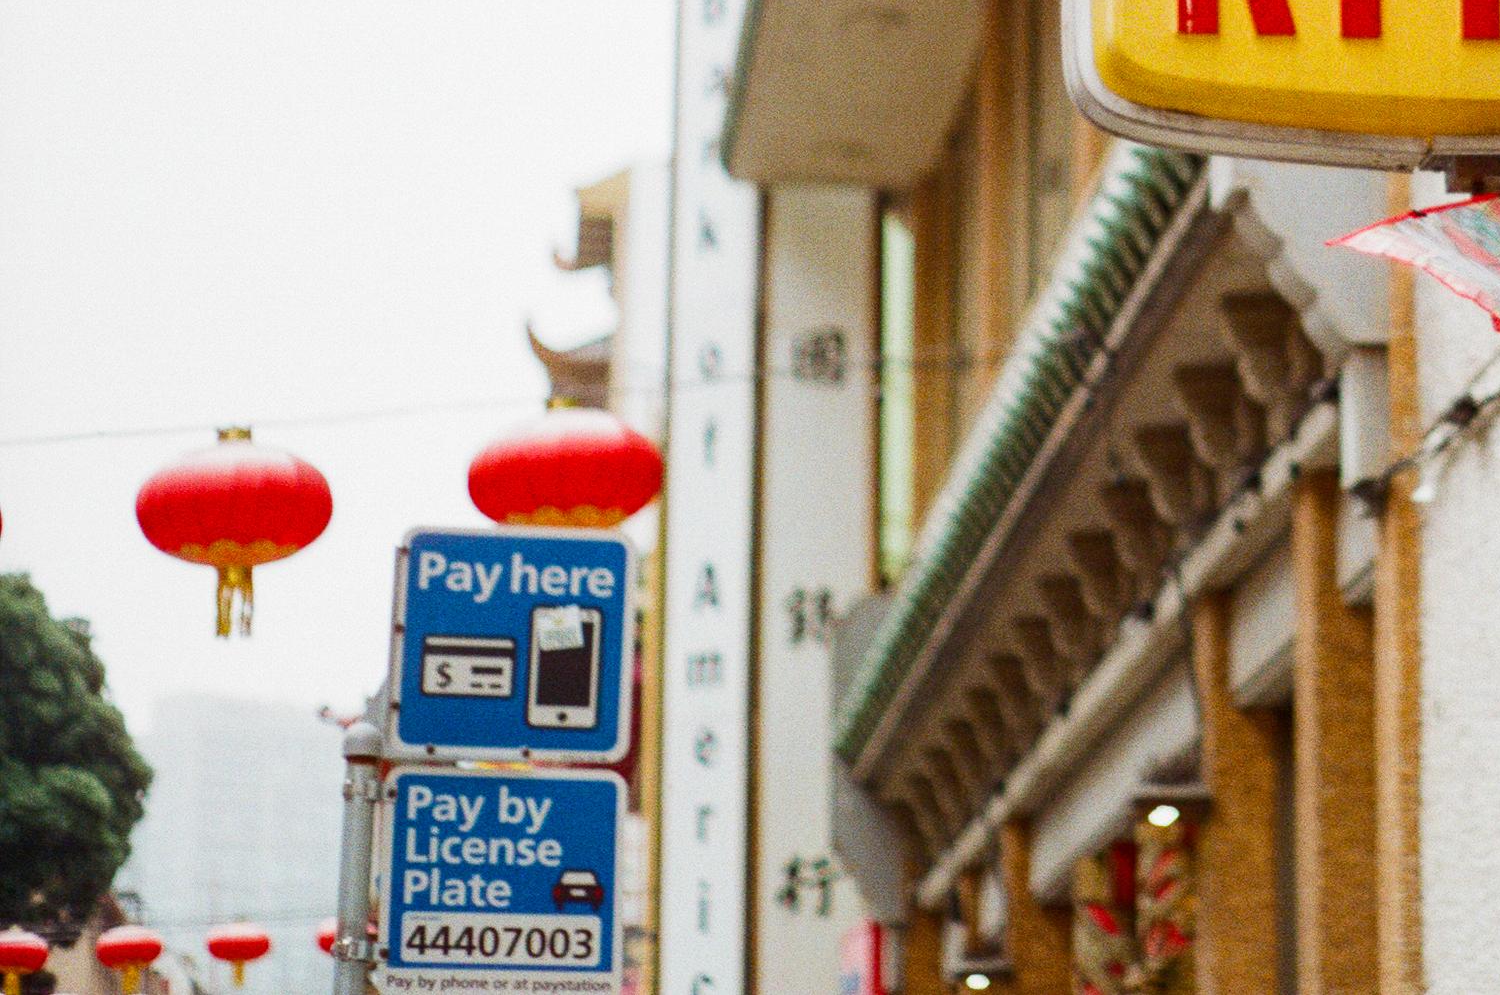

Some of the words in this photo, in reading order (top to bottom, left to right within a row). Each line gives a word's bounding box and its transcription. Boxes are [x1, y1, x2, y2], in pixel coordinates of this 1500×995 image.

[418, 551, 503, 603] Pay
[510, 552, 615, 598] here
[436, 662, 453, 688] $
[406, 785, 485, 832] Pay
[498, 785, 552, 834] by
[405, 826, 563, 867] License
[403, 867, 513, 907] Plate
[406, 924, 593, 959] 44407003
[386, 975, 412, 991] Pay
[418, 975, 435, 990] by
[440, 975, 488, 990] phone
[493, 978, 507, 989] or
[513, 978, 528, 989] at
[532, 979, 611, 993] paystation
